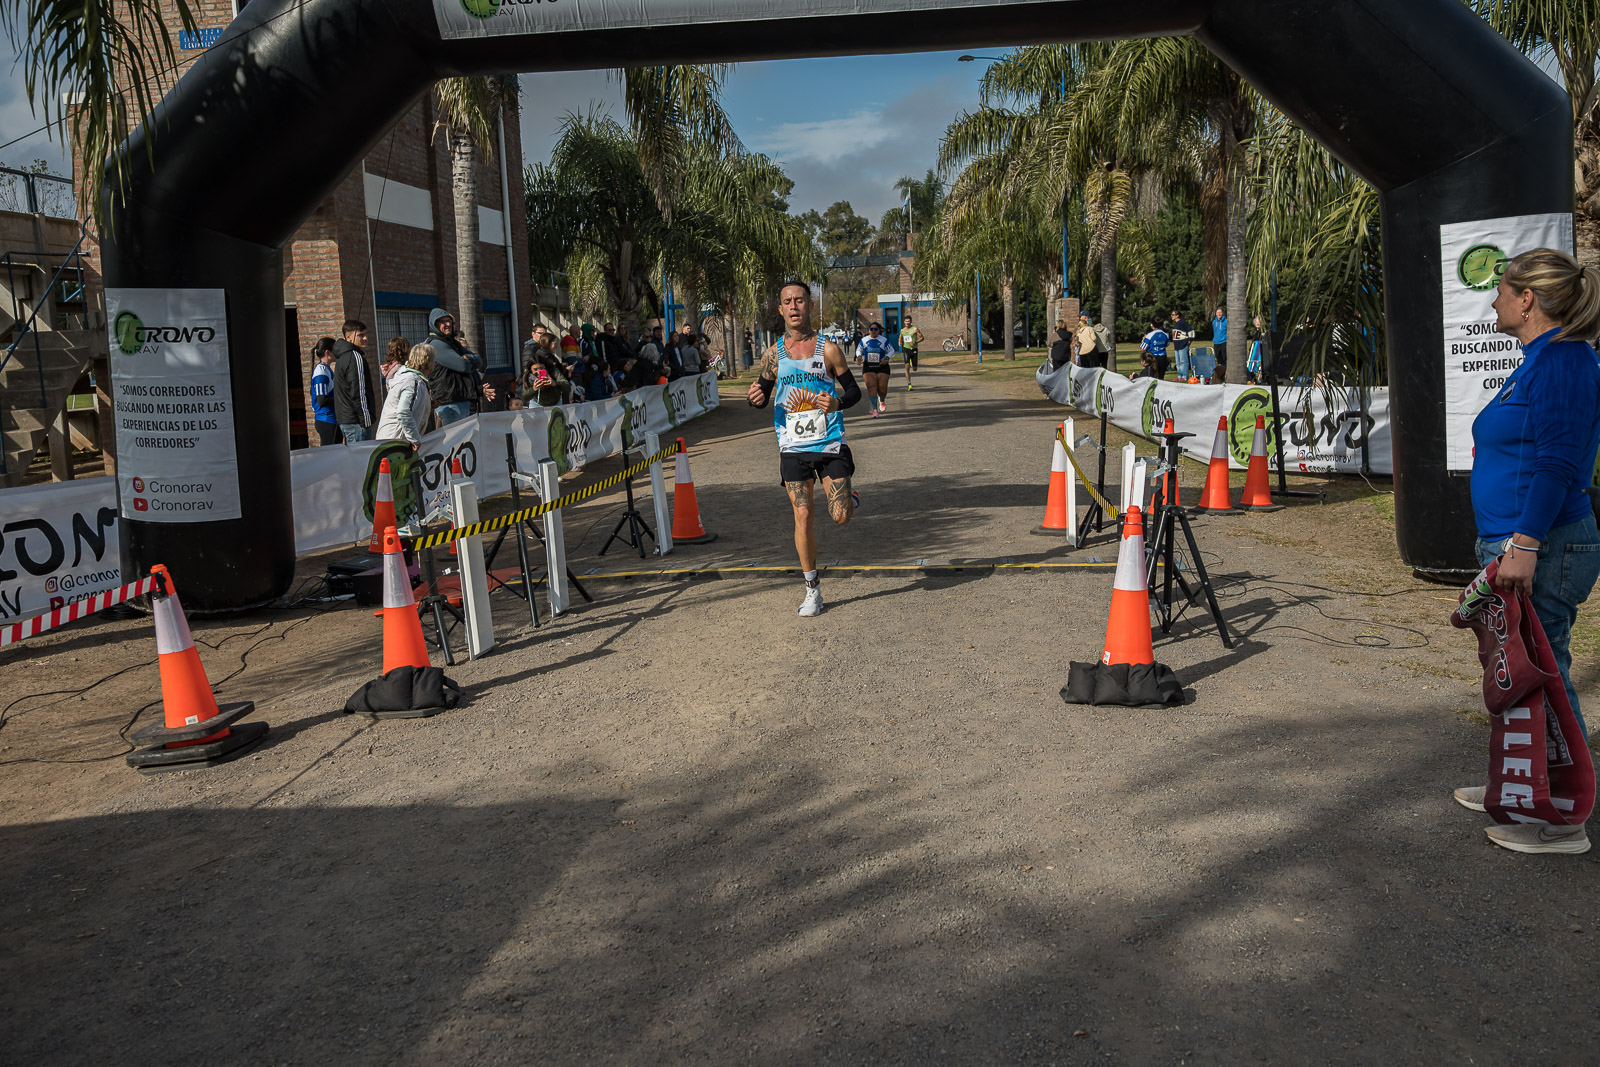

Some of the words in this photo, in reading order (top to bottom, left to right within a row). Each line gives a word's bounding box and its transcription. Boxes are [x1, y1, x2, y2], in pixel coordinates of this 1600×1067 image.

[489, 8, 515, 17] RAV
[135, 327, 215, 343] CRONO
[1460, 322, 1498, 336] “SOMO
[134, 345, 160, 354] RAV
[1451, 340, 1513, 355] BUSCANDO
[1462, 357, 1524, 373] EXPERIENC
[796, 373, 803, 384] ES
[804, 371, 826, 383] POSIBLE
[149, 384, 216, 397] CORREDORES
[116, 401, 155, 414] BUSCANDO
[156, 402, 205, 414] MEJORAR
[207, 401, 226, 413] LAS
[122, 418, 180, 431] EXPERIENCIAS
[183, 420, 196, 431] DE
[199, 419, 218, 430] LOS
[794, 418, 817, 435] 64
[149, 481, 213, 494] Cronorav
[151, 499, 214, 511] Cronorav
[60, 567, 120, 591] @cronor
